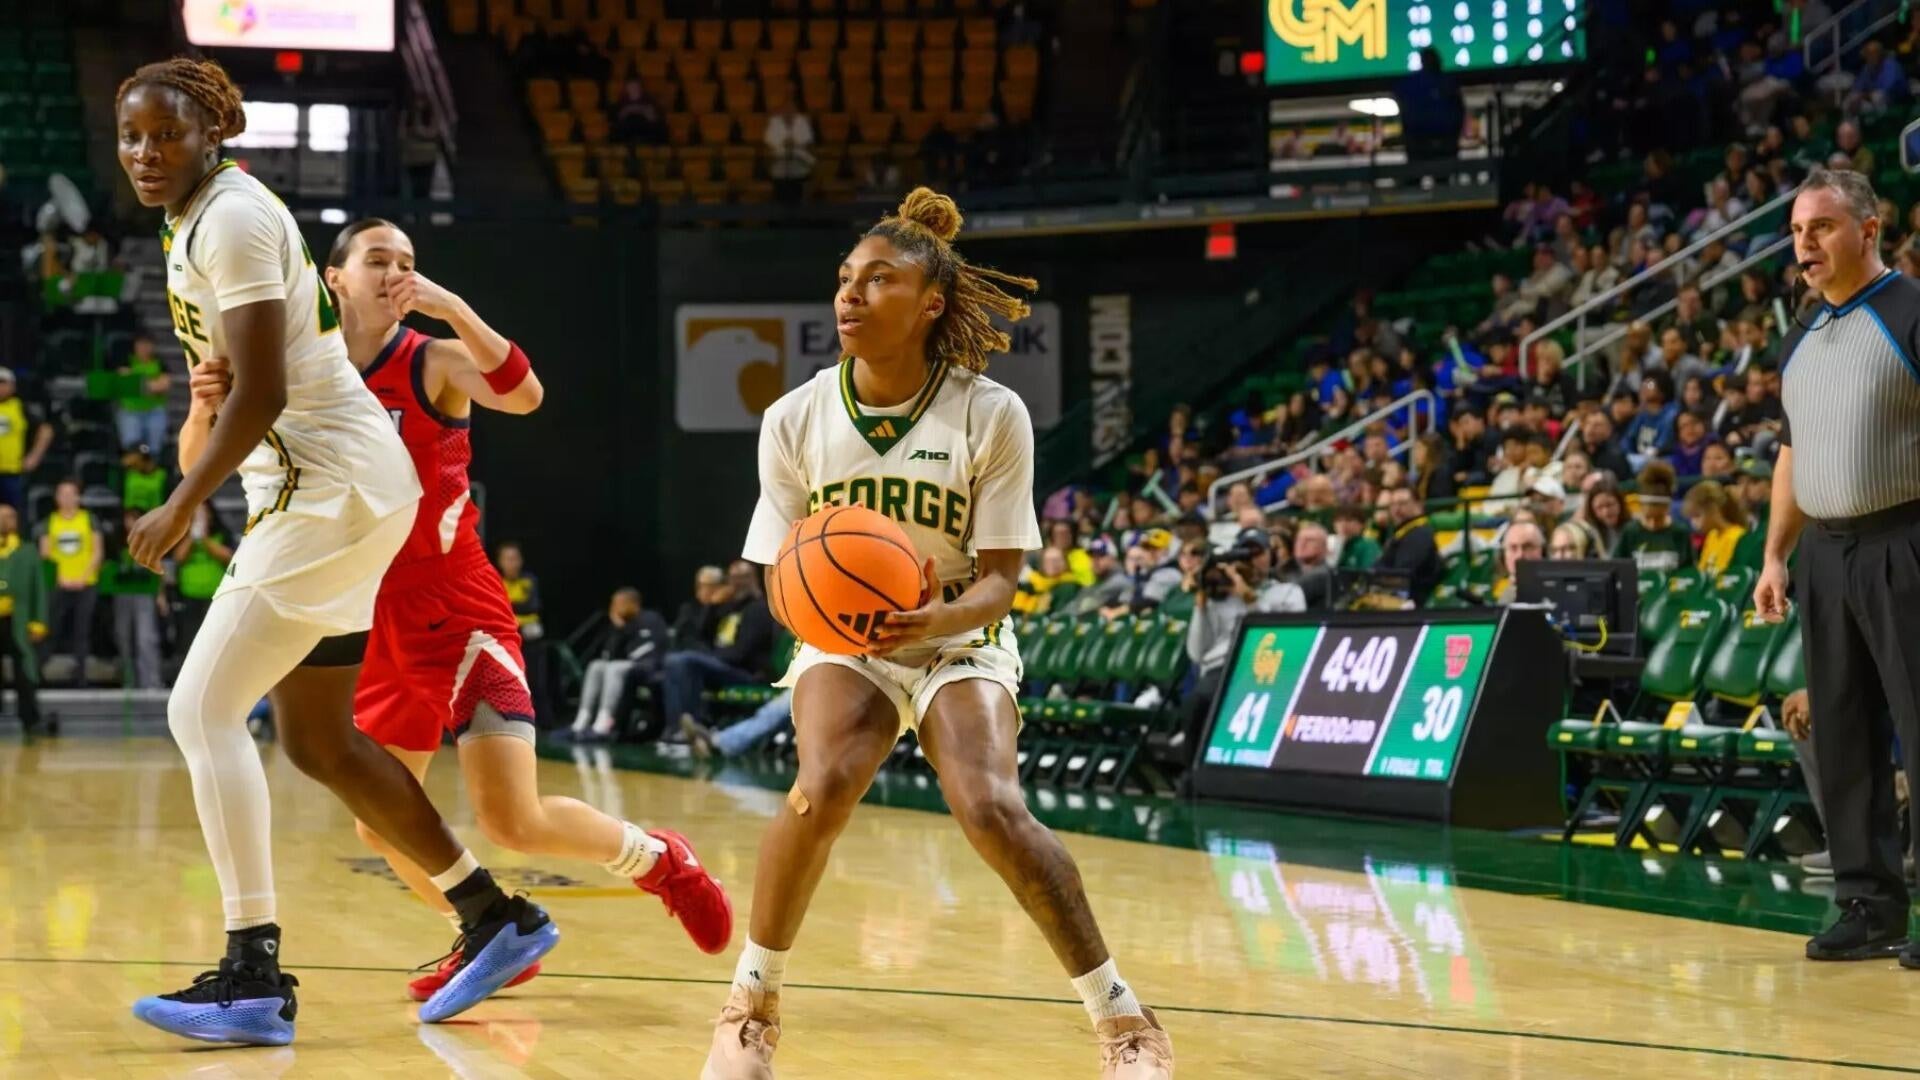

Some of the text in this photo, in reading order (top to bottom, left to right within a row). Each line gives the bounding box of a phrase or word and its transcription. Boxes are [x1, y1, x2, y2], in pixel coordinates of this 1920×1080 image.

[908, 449, 950, 461] A10
[808, 476, 967, 538] GEORGE
[1320, 636, 1398, 693] 4:40
[1228, 692, 1271, 742] 41
[1412, 685, 1464, 743] 30
